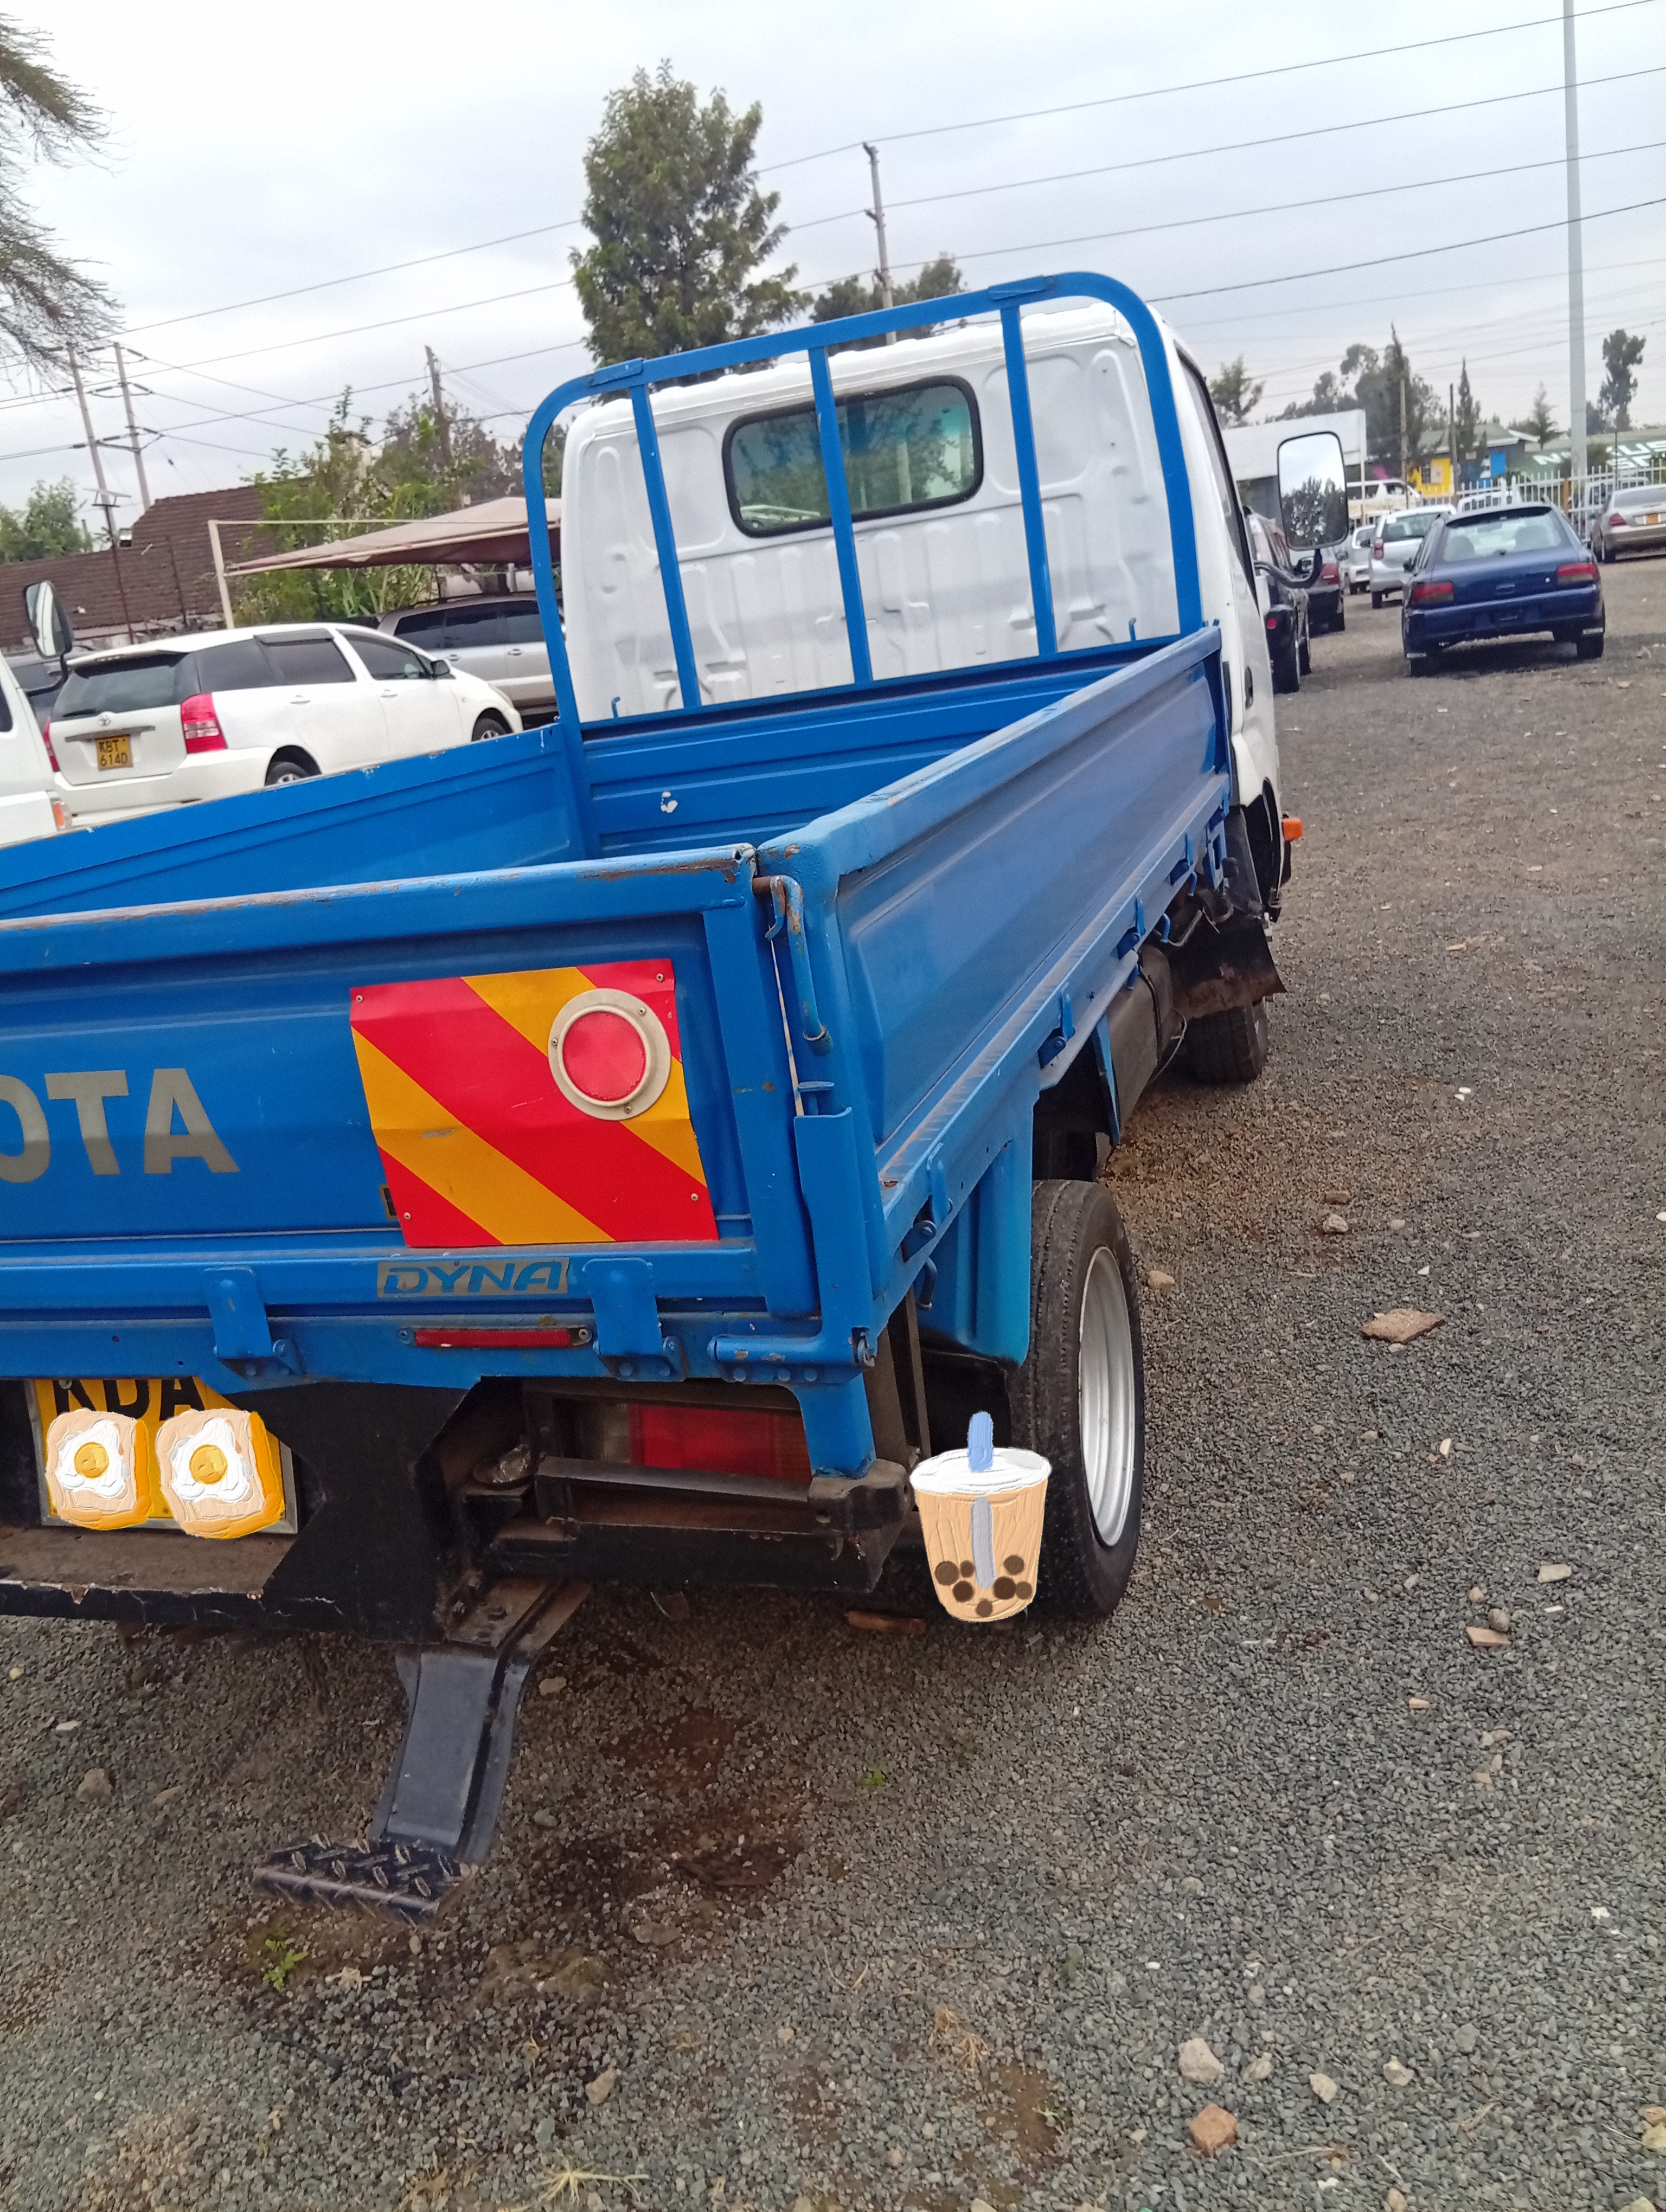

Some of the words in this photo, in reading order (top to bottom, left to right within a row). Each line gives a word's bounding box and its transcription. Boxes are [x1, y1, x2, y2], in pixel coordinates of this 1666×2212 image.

[99, 740, 119, 753] KBT
[0, 1068, 240, 1183] OTA
[384, 1261, 562, 1294] DYNA
